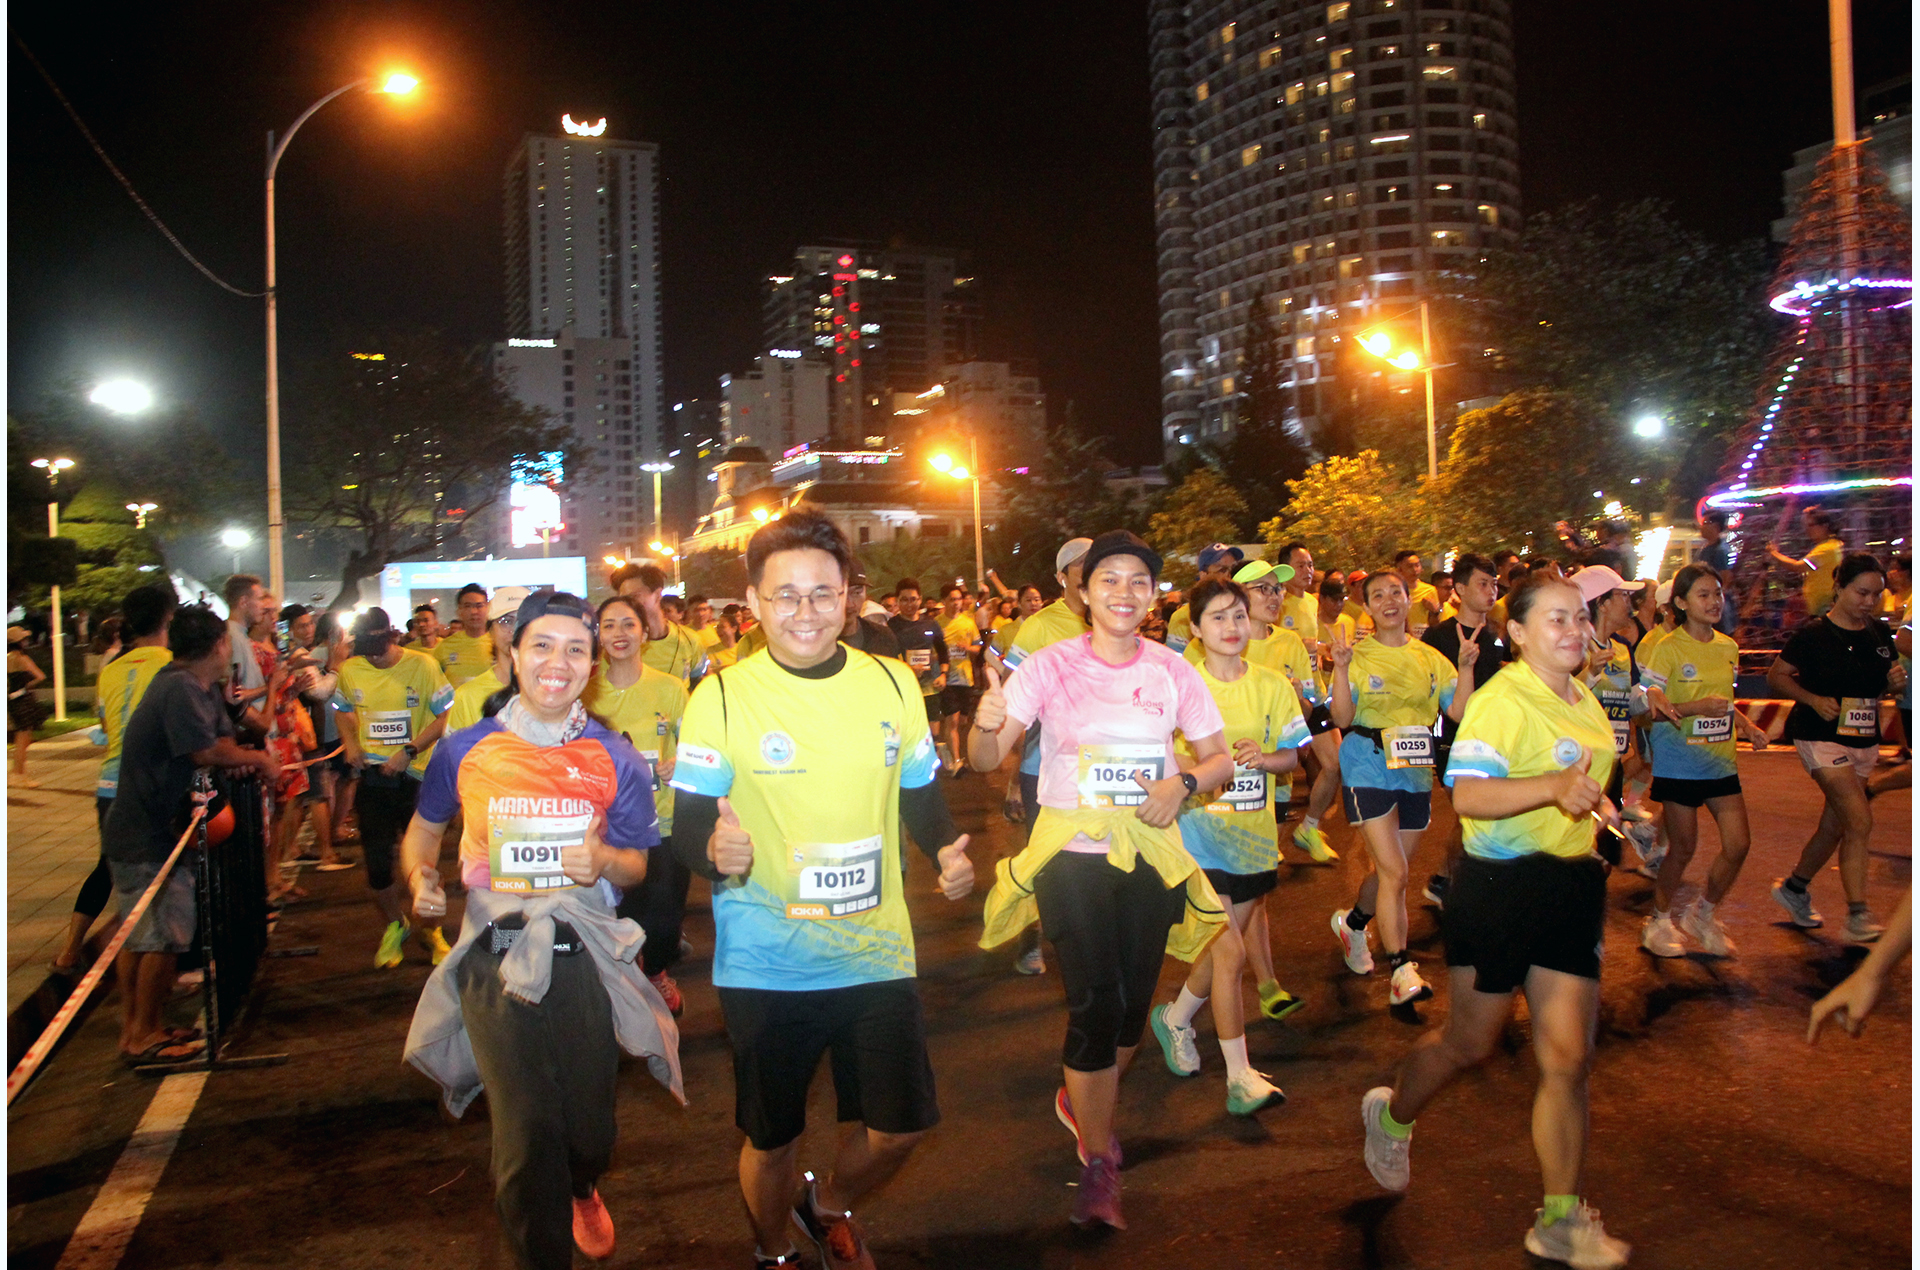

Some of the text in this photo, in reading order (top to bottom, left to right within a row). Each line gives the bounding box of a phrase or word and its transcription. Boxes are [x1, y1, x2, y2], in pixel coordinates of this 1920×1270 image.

[371, 723, 404, 733] 10956
[1697, 719, 1727, 729] 10574
[1395, 740, 1427, 751] 10259
[488, 796, 595, 816] MARVELOUS
[510, 846, 563, 863] 1091
[813, 867, 866, 889] 10112
